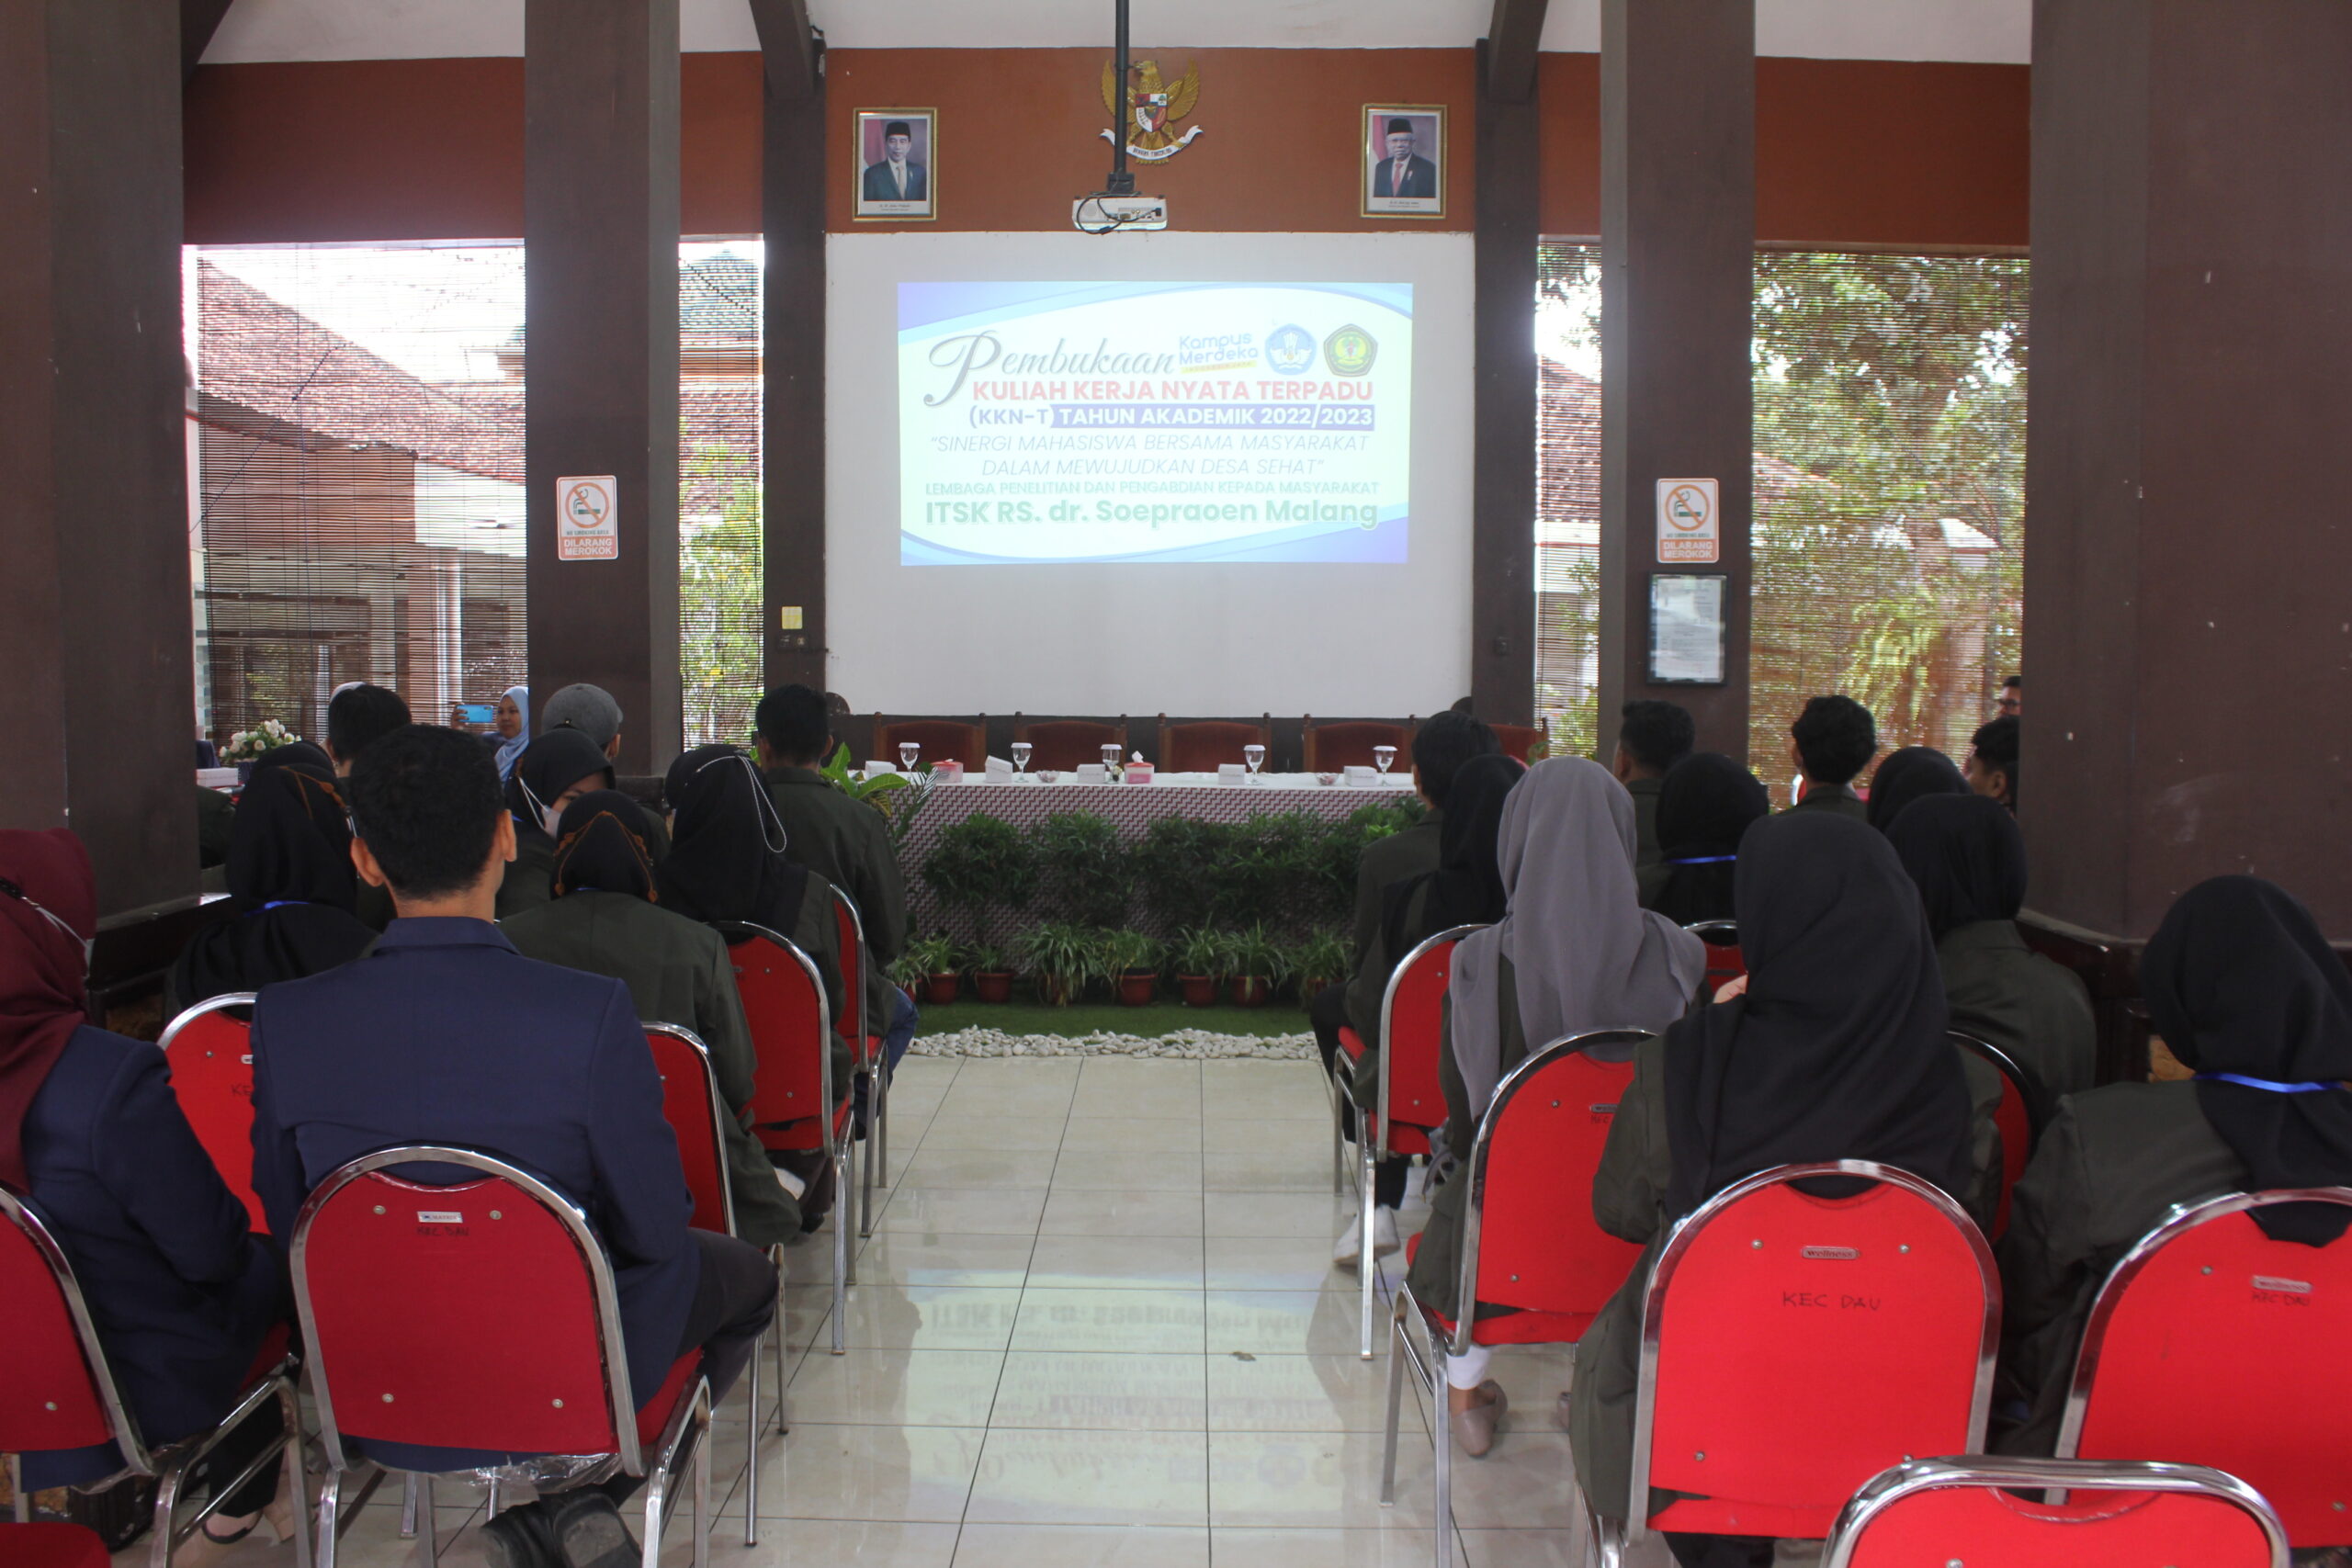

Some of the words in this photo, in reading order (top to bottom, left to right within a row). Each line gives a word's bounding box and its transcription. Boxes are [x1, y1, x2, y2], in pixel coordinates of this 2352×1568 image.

[1179, 333, 1252, 351] Kampus
[1179, 346, 1259, 366] Merdeka
[923, 330, 1176, 407] Pembukaan
[973, 381, 1067, 400] KULIAH
[1073, 380, 1156, 400] KERJA
[1161, 380, 1250, 400] NYATA
[1256, 380, 1374, 400] TERPADU
[969, 405, 1056, 429] (KKN-T)
[1058, 408, 1136, 425] TAHUN
[1140, 407, 1256, 425] AKADEMIK
[1261, 404, 1373, 428] 2022/2023
[931, 435, 1012, 453] "SINERGI
[1017, 434, 1137, 451] MAHASISWA
[1144, 434, 1234, 451] BERSAMA
[1240, 434, 1370, 451] MASYARAKAT
[981, 458, 1050, 476] DALAM
[1056, 457, 1194, 475] MEWUJUDKAN
[1200, 457, 1250, 475] DESA
[1256, 457, 1325, 475] SEHAT"
[925, 482, 995, 496] LEMBAGA
[1000, 480, 1081, 495] PENELITIAN
[1083, 480, 1115, 494] DAN
[1119, 479, 1215, 494] PENGABDIAN
[1218, 479, 1275, 494] KEPADA
[1279, 480, 1380, 495] MASYARAKAT
[926, 501, 990, 524] ITSK
[998, 500, 1043, 523] RS.
[1049, 499, 1089, 522] dr.
[1096, 499, 1258, 529] Soepraoen
[1265, 499, 1379, 530] Malang
[564, 538, 612, 547] DILARANG
[565, 547, 612, 555] MEROKOK
[1664, 541, 1713, 550] DILARANG
[1664, 549, 1713, 558] MEROKOK
[1783, 1291, 1828, 1308] KEC
[1840, 1293, 1882, 1312] DAU
